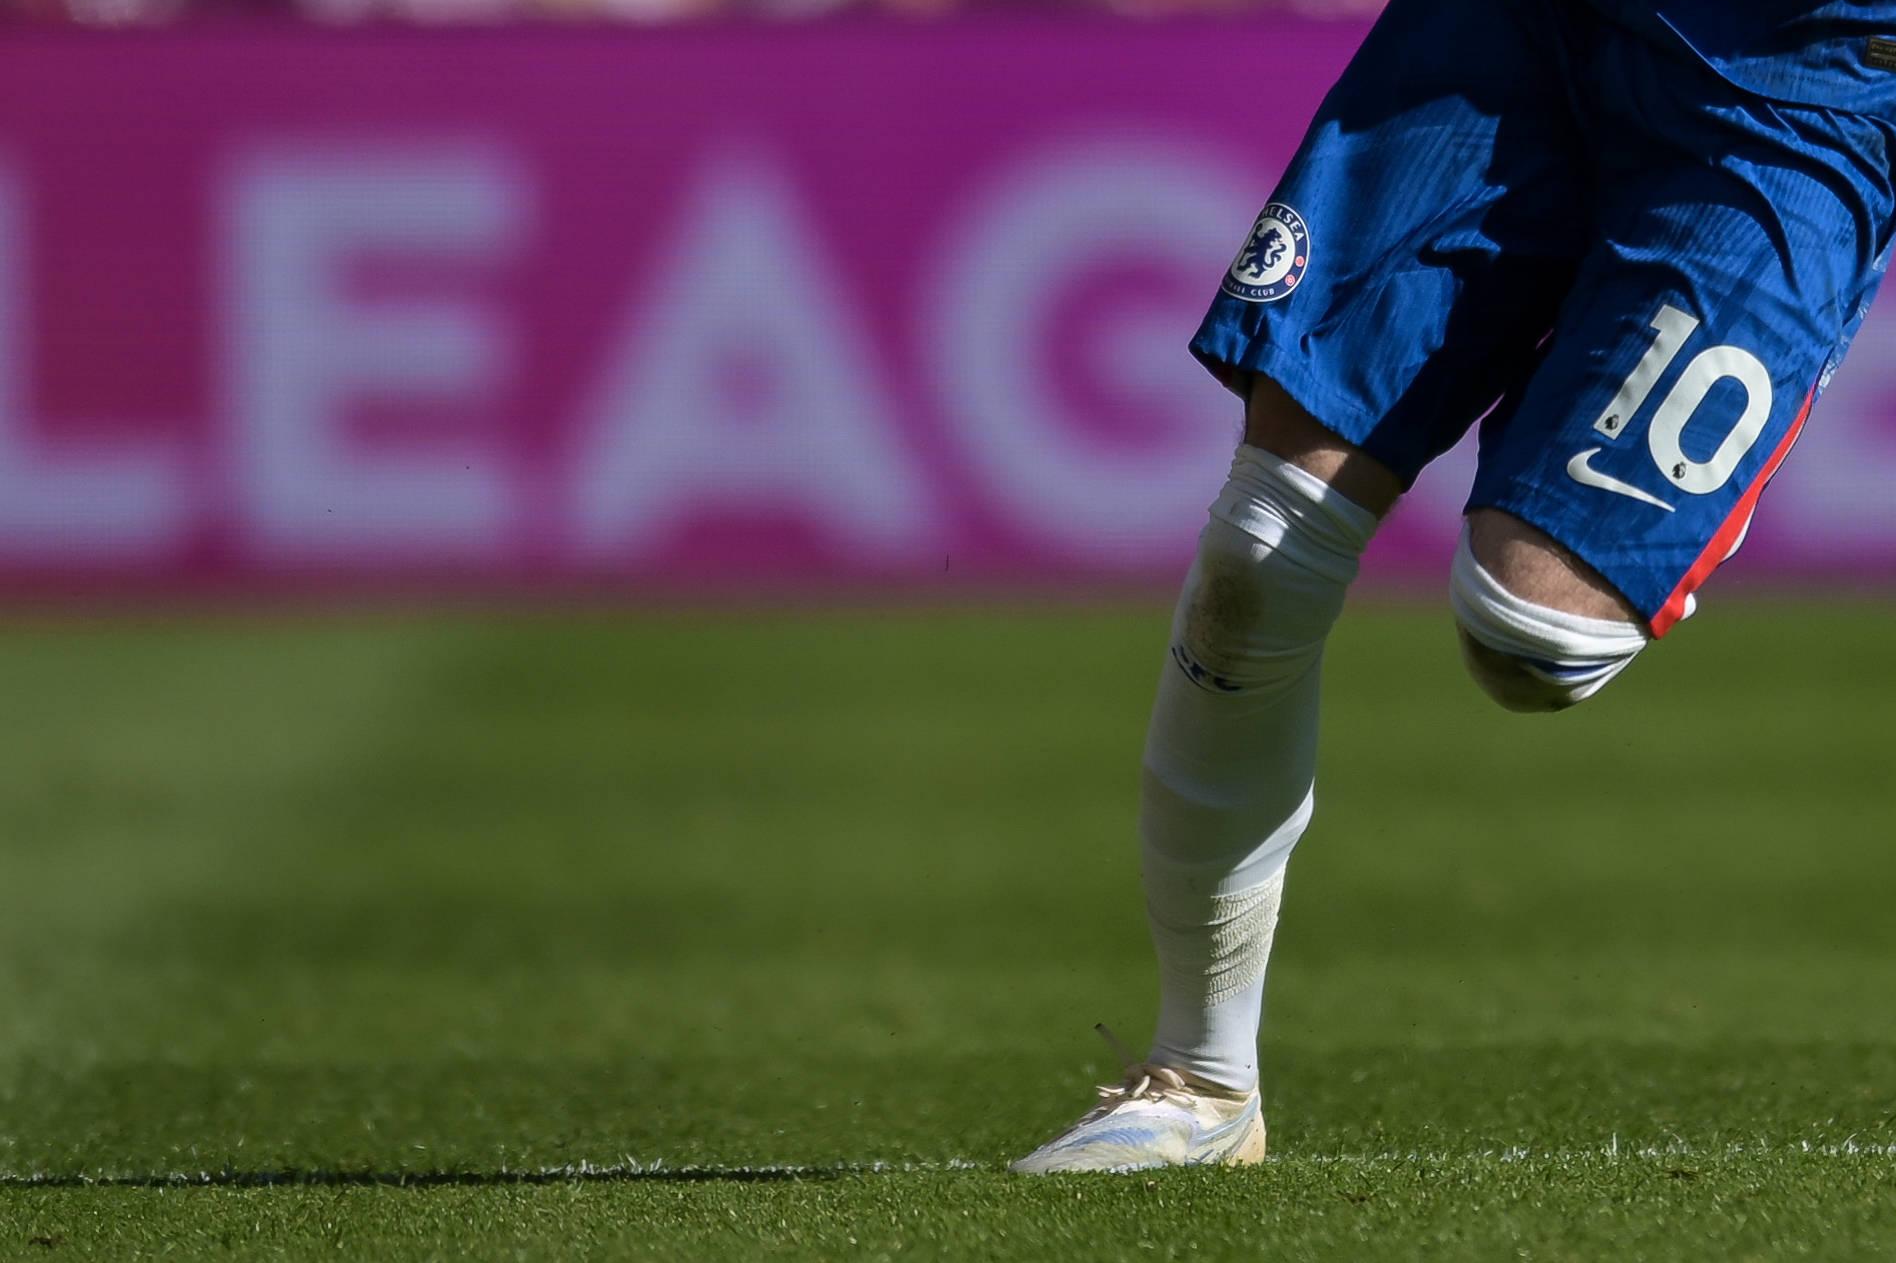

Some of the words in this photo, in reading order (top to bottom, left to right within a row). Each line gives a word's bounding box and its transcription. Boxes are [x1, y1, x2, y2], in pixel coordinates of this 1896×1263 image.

[1261, 206, 1305, 242] HELSEA
[1250, 287, 1275, 297] CLUB
[1593, 303, 1774, 495] 10
